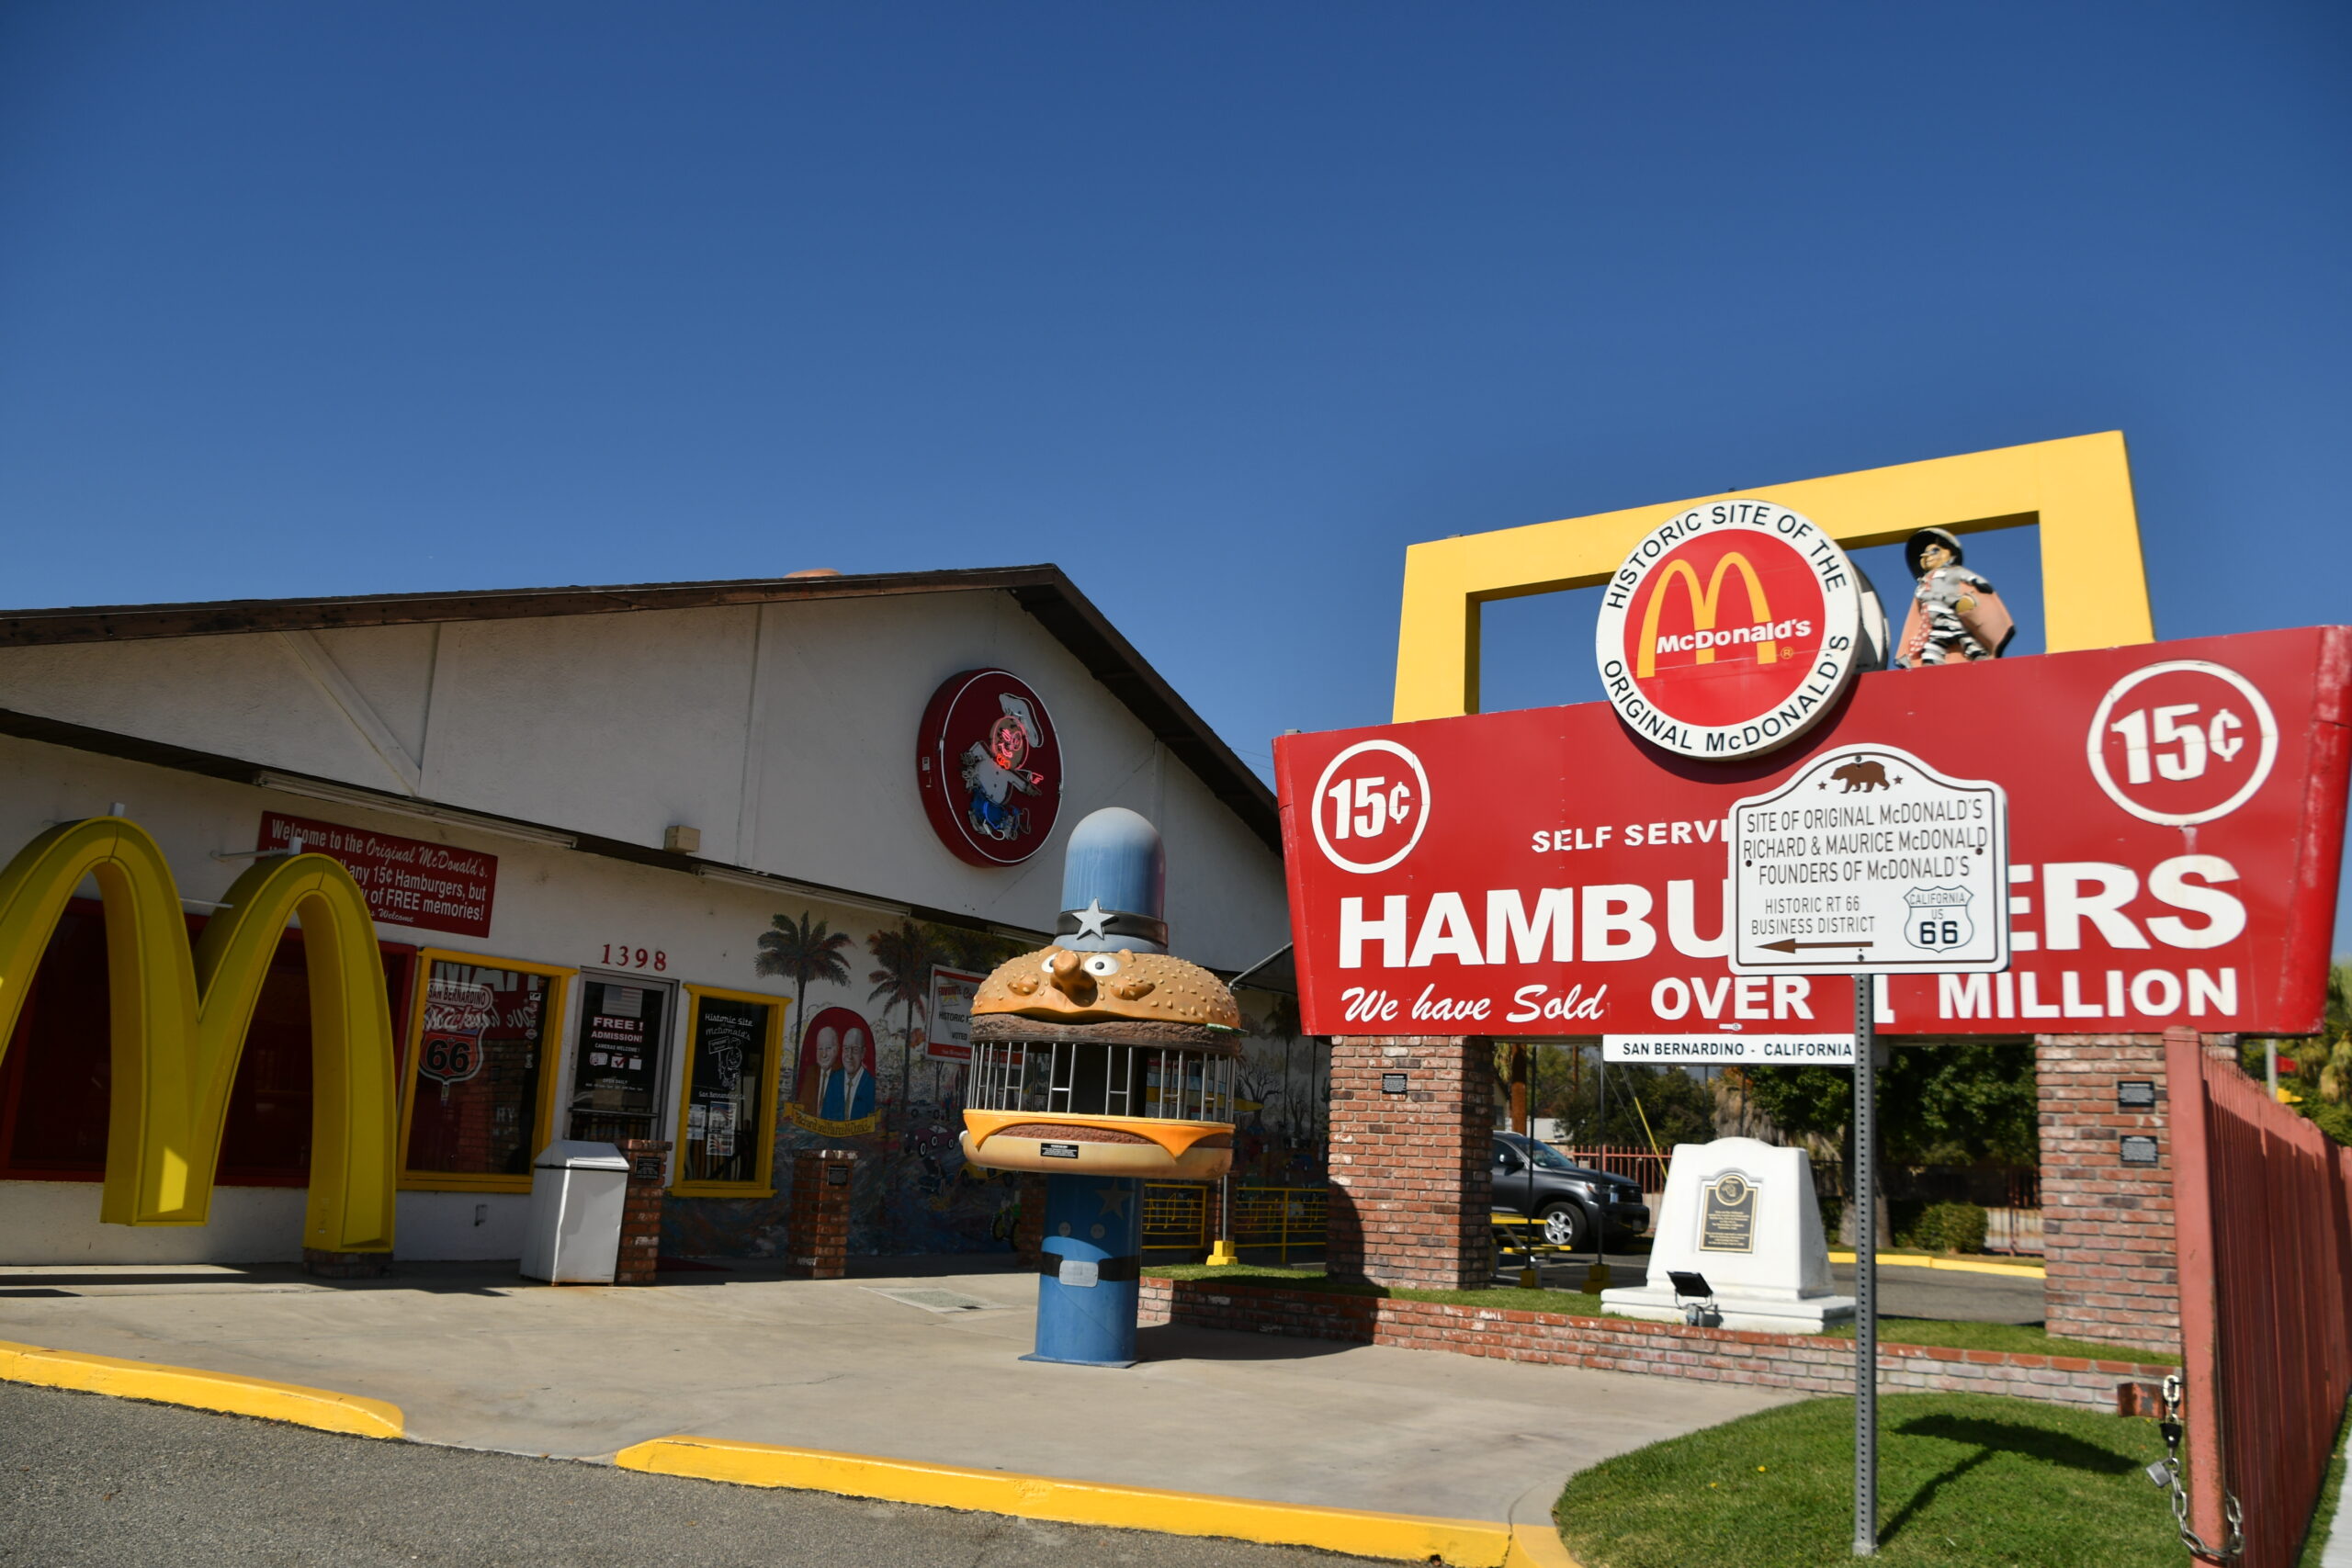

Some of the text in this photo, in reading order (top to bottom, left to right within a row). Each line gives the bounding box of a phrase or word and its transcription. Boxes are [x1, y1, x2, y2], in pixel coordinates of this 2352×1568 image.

[1607, 503, 1847, 609] HISTORIC SITE OF THE
[1656, 618, 1812, 655] McDonald's
[1604, 634, 1849, 752] ORIGINAL McDONALD'S
[2110, 703, 2244, 785] 15¢
[1327, 775, 1410, 840] 15¢
[1747, 798, 1983, 833] SITE OF ORIGINAL McDONALD'S
[272, 818, 325, 847] Welcome
[330, 832, 341, 851] to
[345, 833, 363, 853] the
[366, 837, 415, 865] Original
[1531, 818, 1729, 853] SELF SERVI
[1744, 826, 1987, 860] RICHARD & MAURICE McDONALD
[349, 865, 486, 902] any 15¢ Hamburgers, but
[1759, 856, 1970, 885] FOUNDERS OF McDONALD'S
[370, 891, 384, 905] of
[386, 888, 420, 911] FREE
[423, 897, 484, 921] memories!
[1765, 896, 1860, 914] HISTORIC RT 66
[1909, 892, 1966, 906] CALIFORNIA
[1931, 908, 1944, 919] US
[1751, 916, 1875, 935] BUSINESS DISTRICT
[1919, 920, 1959, 944] 66
[601, 943, 667, 972] 1398
[429, 985, 487, 1006] SAN BERNARDINO
[1341, 987, 1397, 1022] We
[1411, 983, 1491, 1021] have
[1506, 984, 1609, 1023] Sold
[1651, 975, 1813, 1021] OVER
[1939, 967, 2239, 1020] MILLION
[593, 1016, 634, 1031] FREE
[737, 1018, 753, 1027] Site
[939, 1011, 964, 1022] HISTORIC
[591, 1031, 643, 1043] ADMISSION!
[1623, 1043, 1650, 1055] SAN
[1655, 1042, 1744, 1055] BERNARDINO
[1764, 1043, 1853, 1056] CALIFORNIA
[426, 1040, 470, 1073] 66
